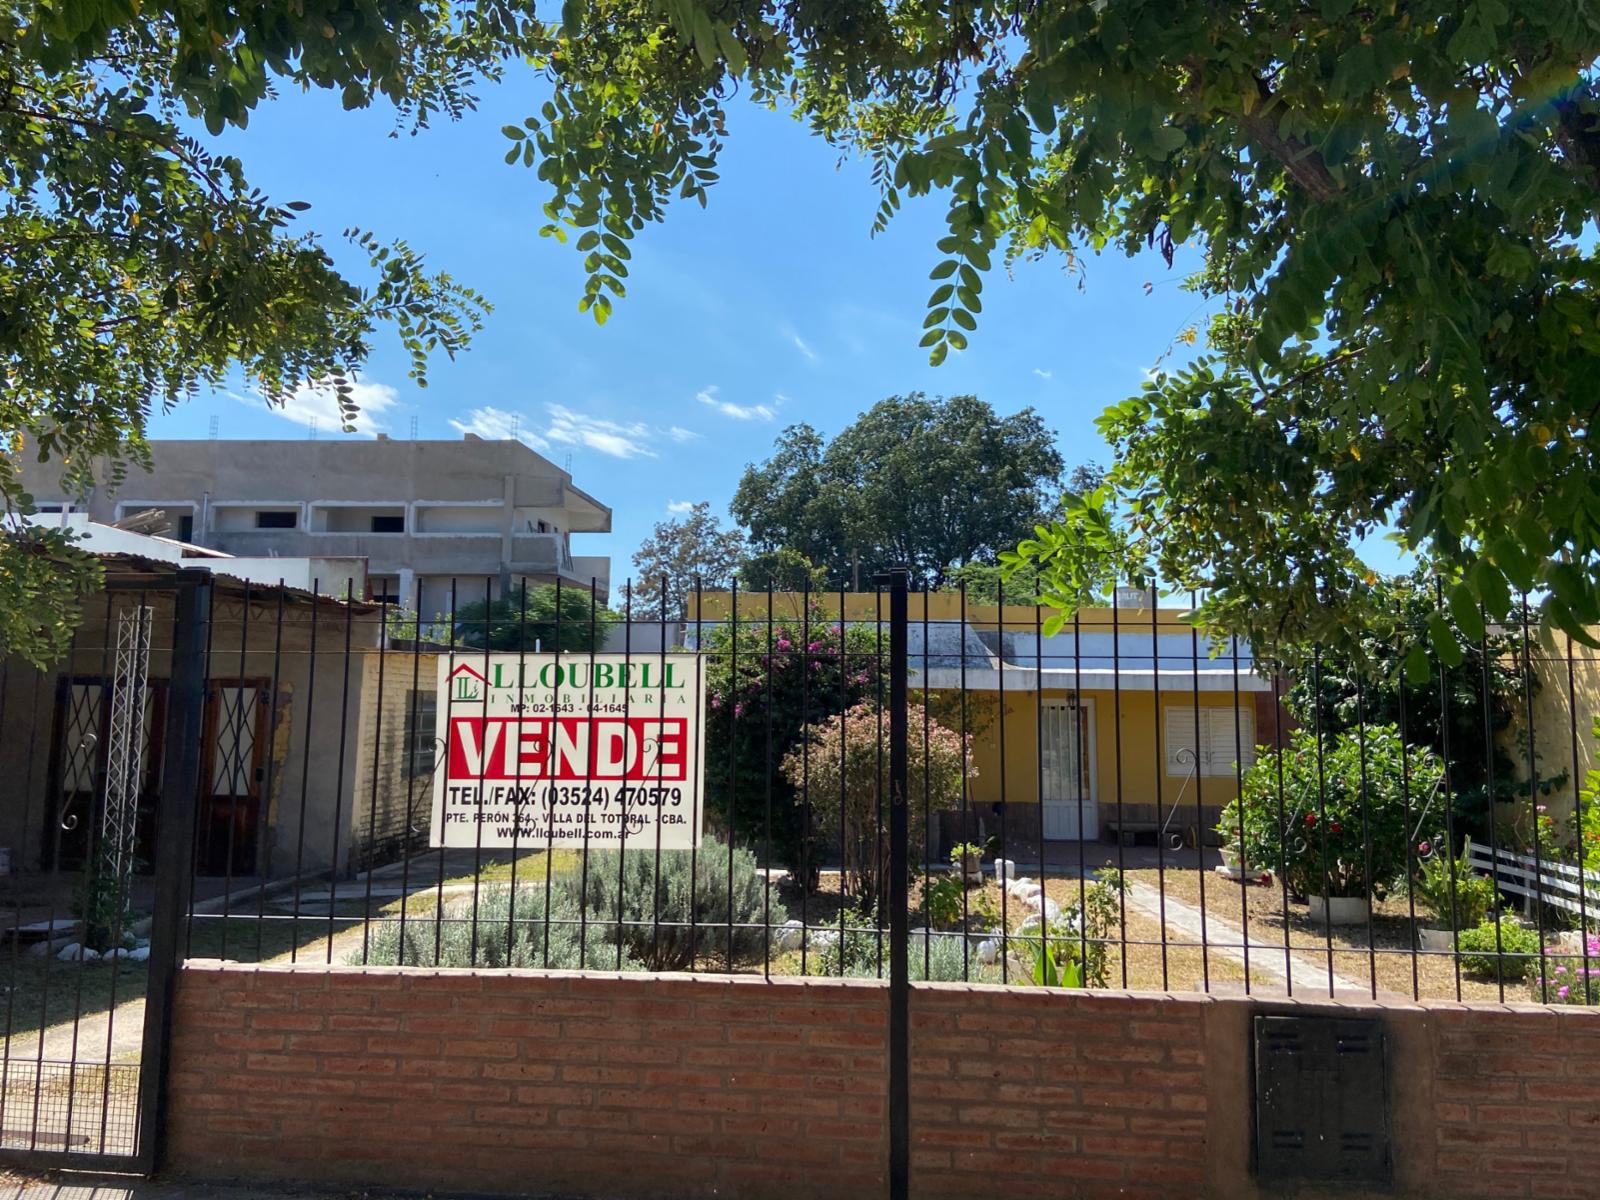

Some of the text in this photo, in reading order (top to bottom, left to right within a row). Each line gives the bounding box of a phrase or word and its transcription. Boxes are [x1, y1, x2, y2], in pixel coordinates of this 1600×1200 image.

[492, 662, 686, 689] LLOUBELL
[456, 721, 681, 777] VENDE
[448, 786, 682, 811] TEL./FAX: (03524) 470579
[446, 812, 469, 823] PTE.
[473, 810, 510, 823] PERÓN
[542, 813, 573, 823] VLLA
[600, 813, 652, 824] TOTORAL
[661, 814, 687, 825] CBA.
